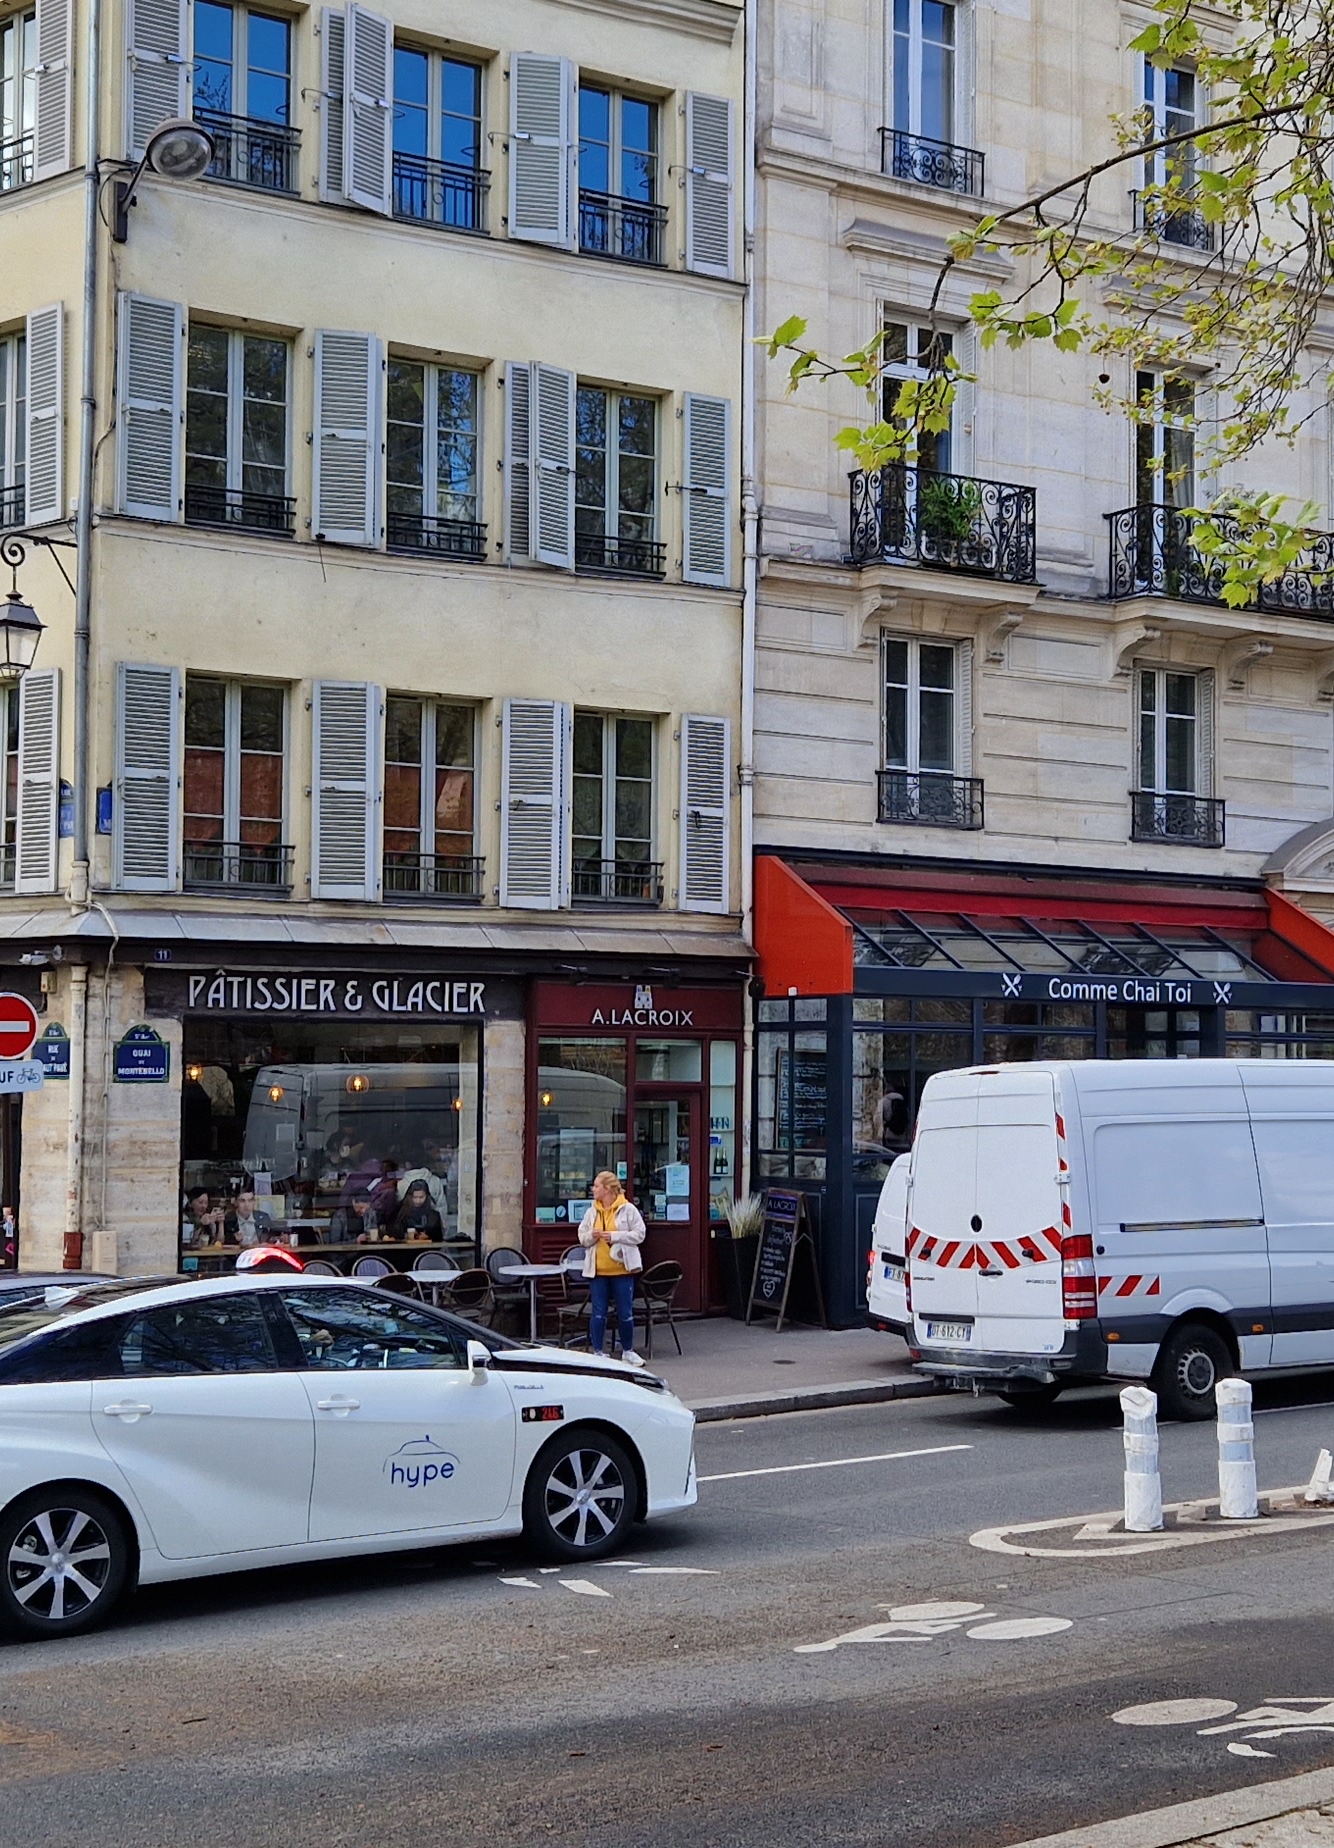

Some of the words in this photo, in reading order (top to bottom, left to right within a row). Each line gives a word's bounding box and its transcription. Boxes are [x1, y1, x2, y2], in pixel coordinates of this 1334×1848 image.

[188, 968, 337, 1011] PÂTISSIER
[344, 978, 363, 1011] &
[372, 980, 486, 1013] GLACIER
[1048, 978, 1117, 1000] Comme
[1123, 980, 1160, 1002] Chai
[1165, 982, 1192, 1003] Toi
[591, 1009, 694, 1026] A.LACROIX
[48, 1044, 59, 1054] RUE
[132, 1049, 151, 1057] QUAI
[117, 1067, 165, 1075] MONTEBELLO
[391, 1462, 455, 1488] hype
